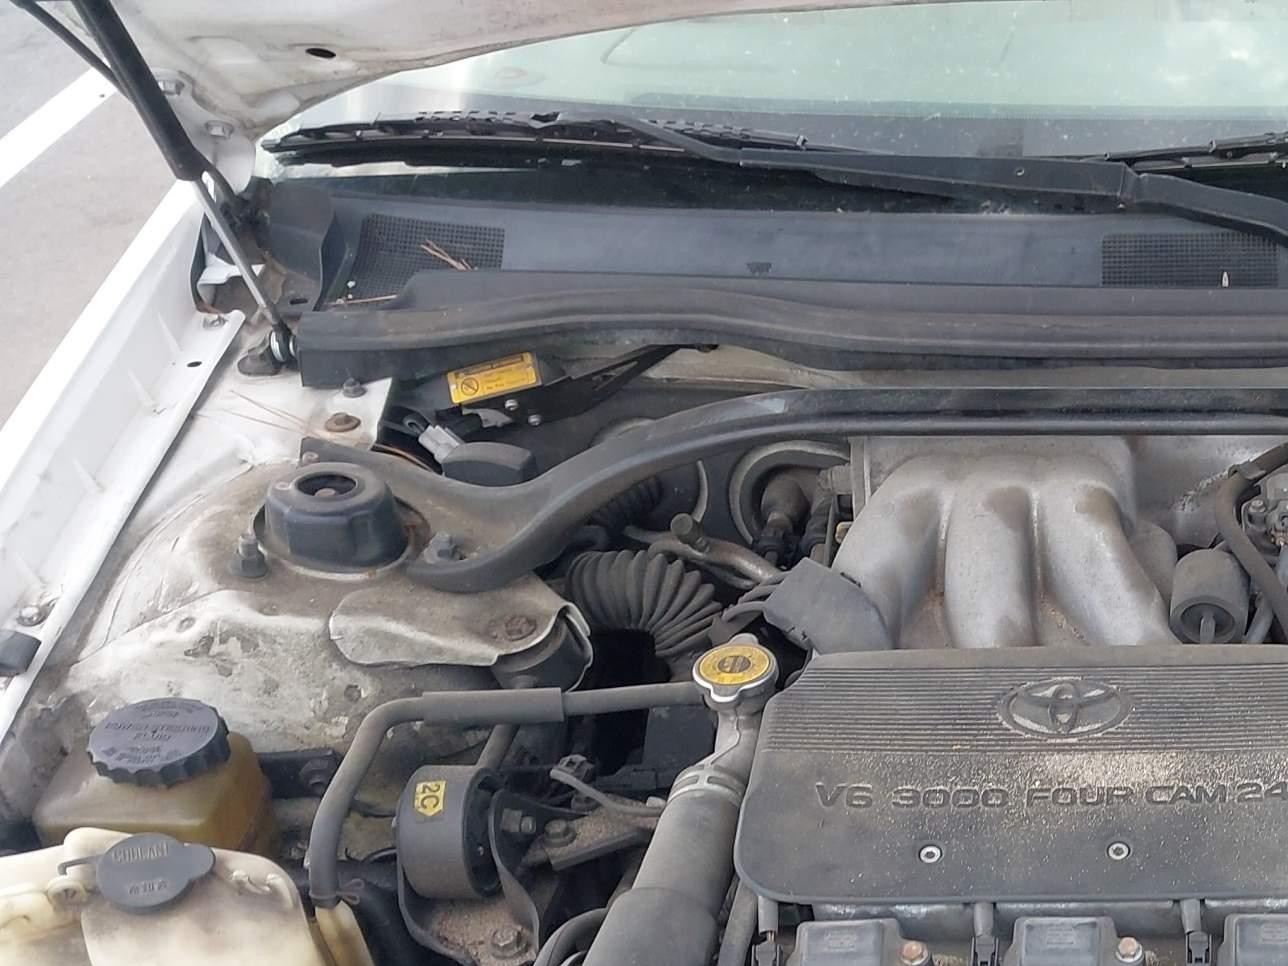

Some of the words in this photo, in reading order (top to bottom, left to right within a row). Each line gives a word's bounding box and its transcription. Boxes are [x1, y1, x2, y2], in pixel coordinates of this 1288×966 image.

[420, 784, 441, 809] 2C
[815, 782, 873, 809] V6
[891, 785, 1009, 809] 3000
[1026, 784, 1135, 808] FOUR
[1146, 783, 1228, 805] CAM
